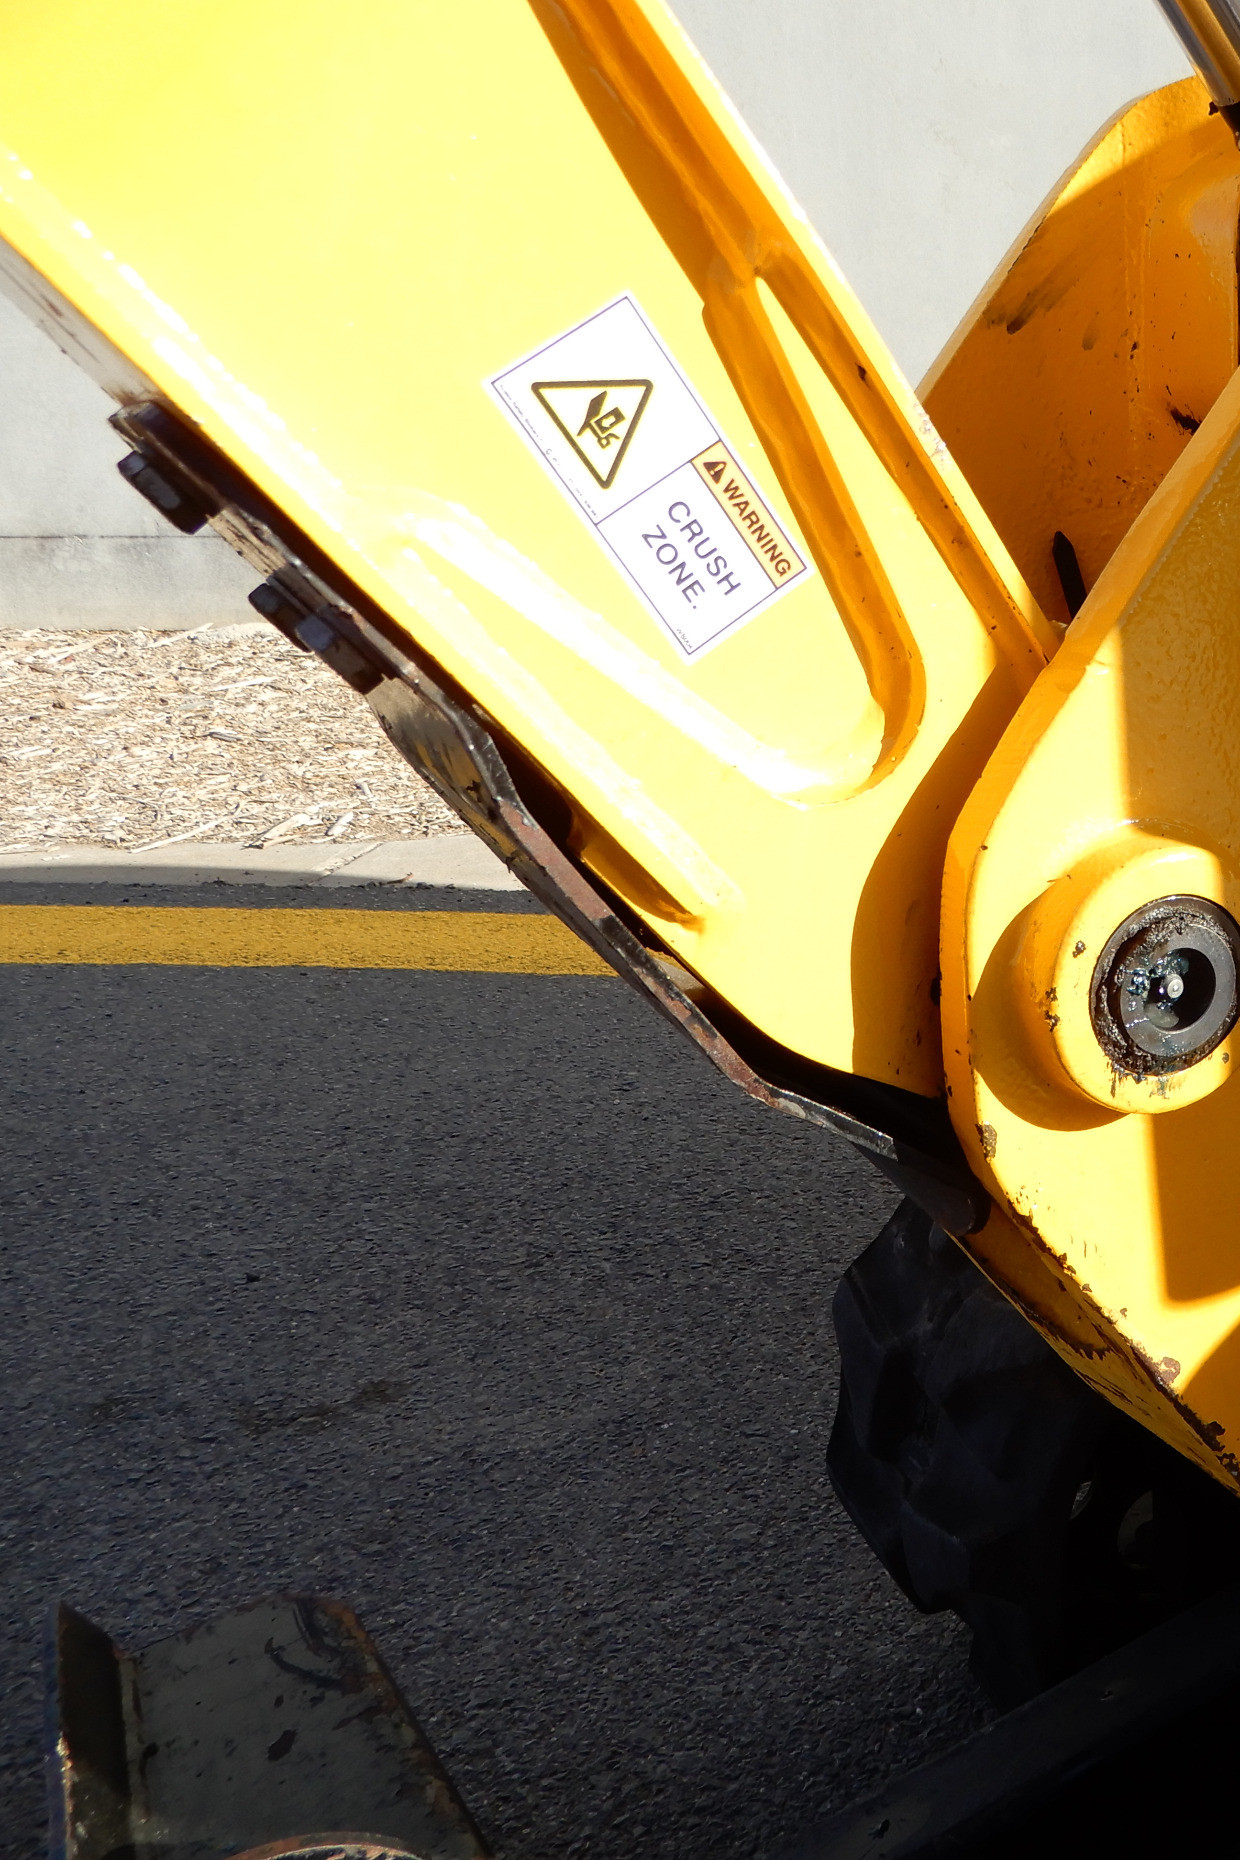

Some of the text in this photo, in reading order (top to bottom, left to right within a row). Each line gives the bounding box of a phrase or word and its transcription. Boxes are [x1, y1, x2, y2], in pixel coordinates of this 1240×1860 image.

[641, 524, 706, 610] ZONE.
[667, 501, 742, 596] CRUSH
[722, 479, 791, 577] WARNING
